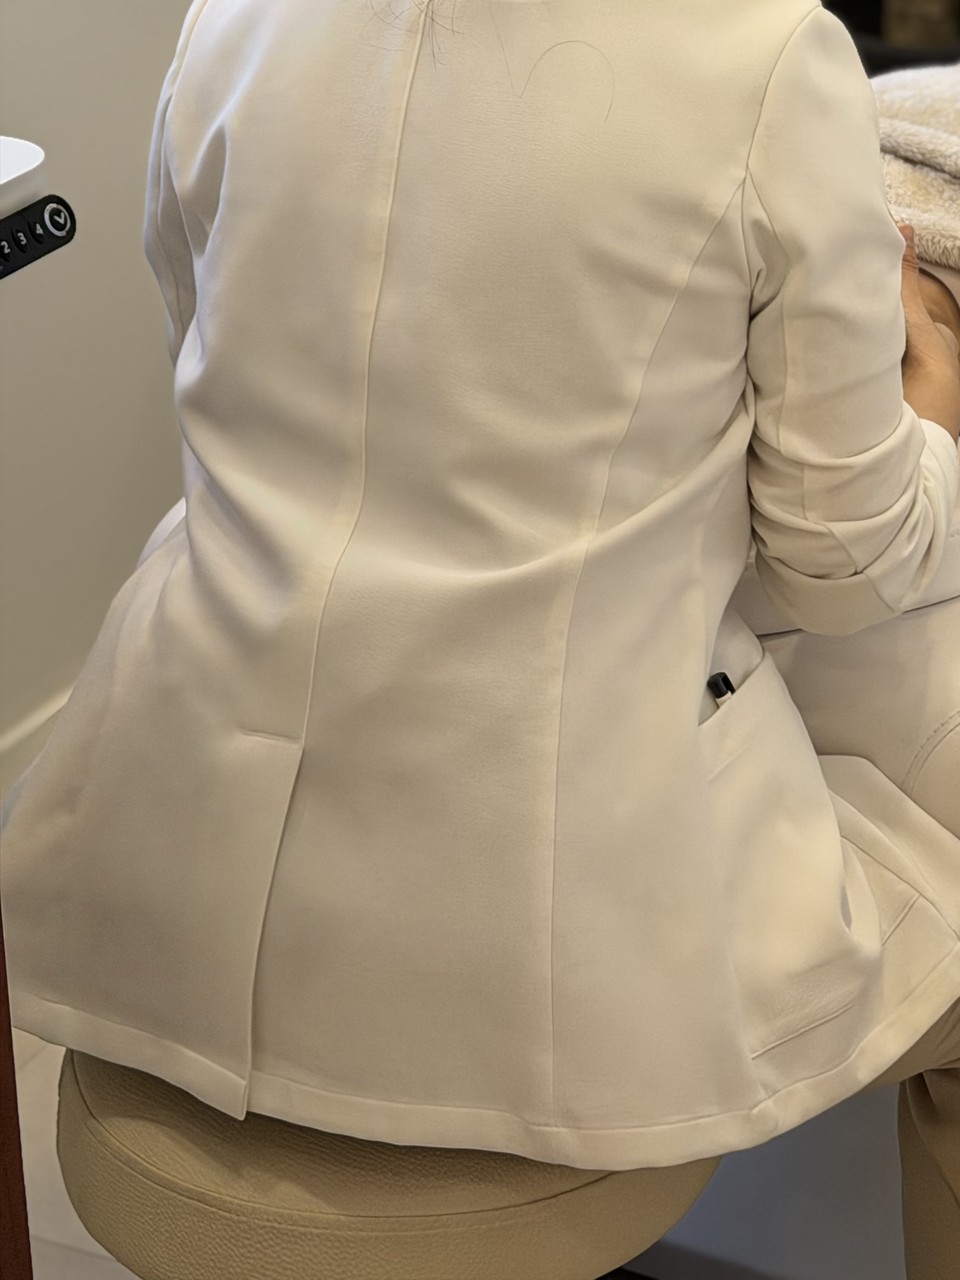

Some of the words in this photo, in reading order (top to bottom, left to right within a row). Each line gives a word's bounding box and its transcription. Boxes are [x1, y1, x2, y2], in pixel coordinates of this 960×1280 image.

[0, 241, 11, 254] 2
[17, 232, 27, 245] 3
[35, 223, 44, 235] 4
